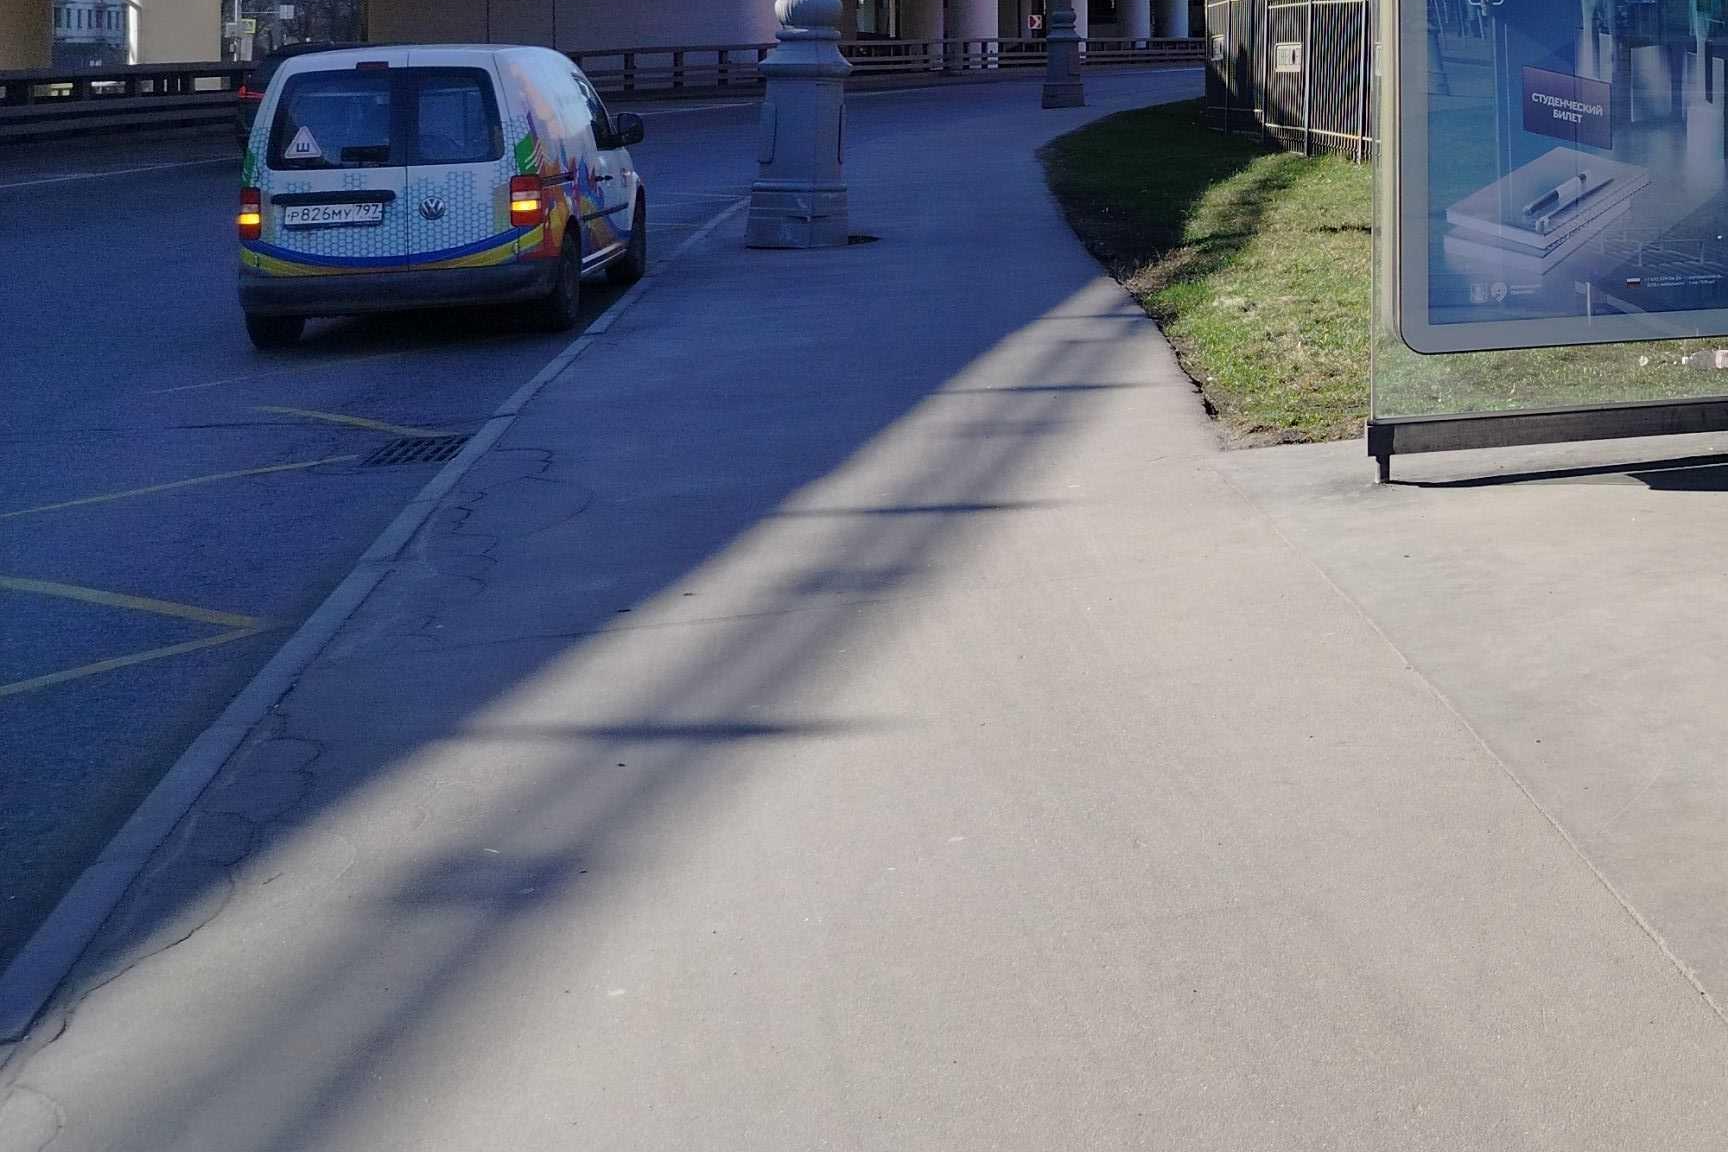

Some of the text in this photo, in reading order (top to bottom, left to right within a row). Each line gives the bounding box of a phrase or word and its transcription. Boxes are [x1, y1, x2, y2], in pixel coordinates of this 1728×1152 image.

[1531, 92, 1604, 117] СТУДЕНЧЕСКИЙ
[1552, 108, 1583, 123] БИЛЕТ
[296, 142, 310, 153] Ш
[355, 204, 380, 216] 797
